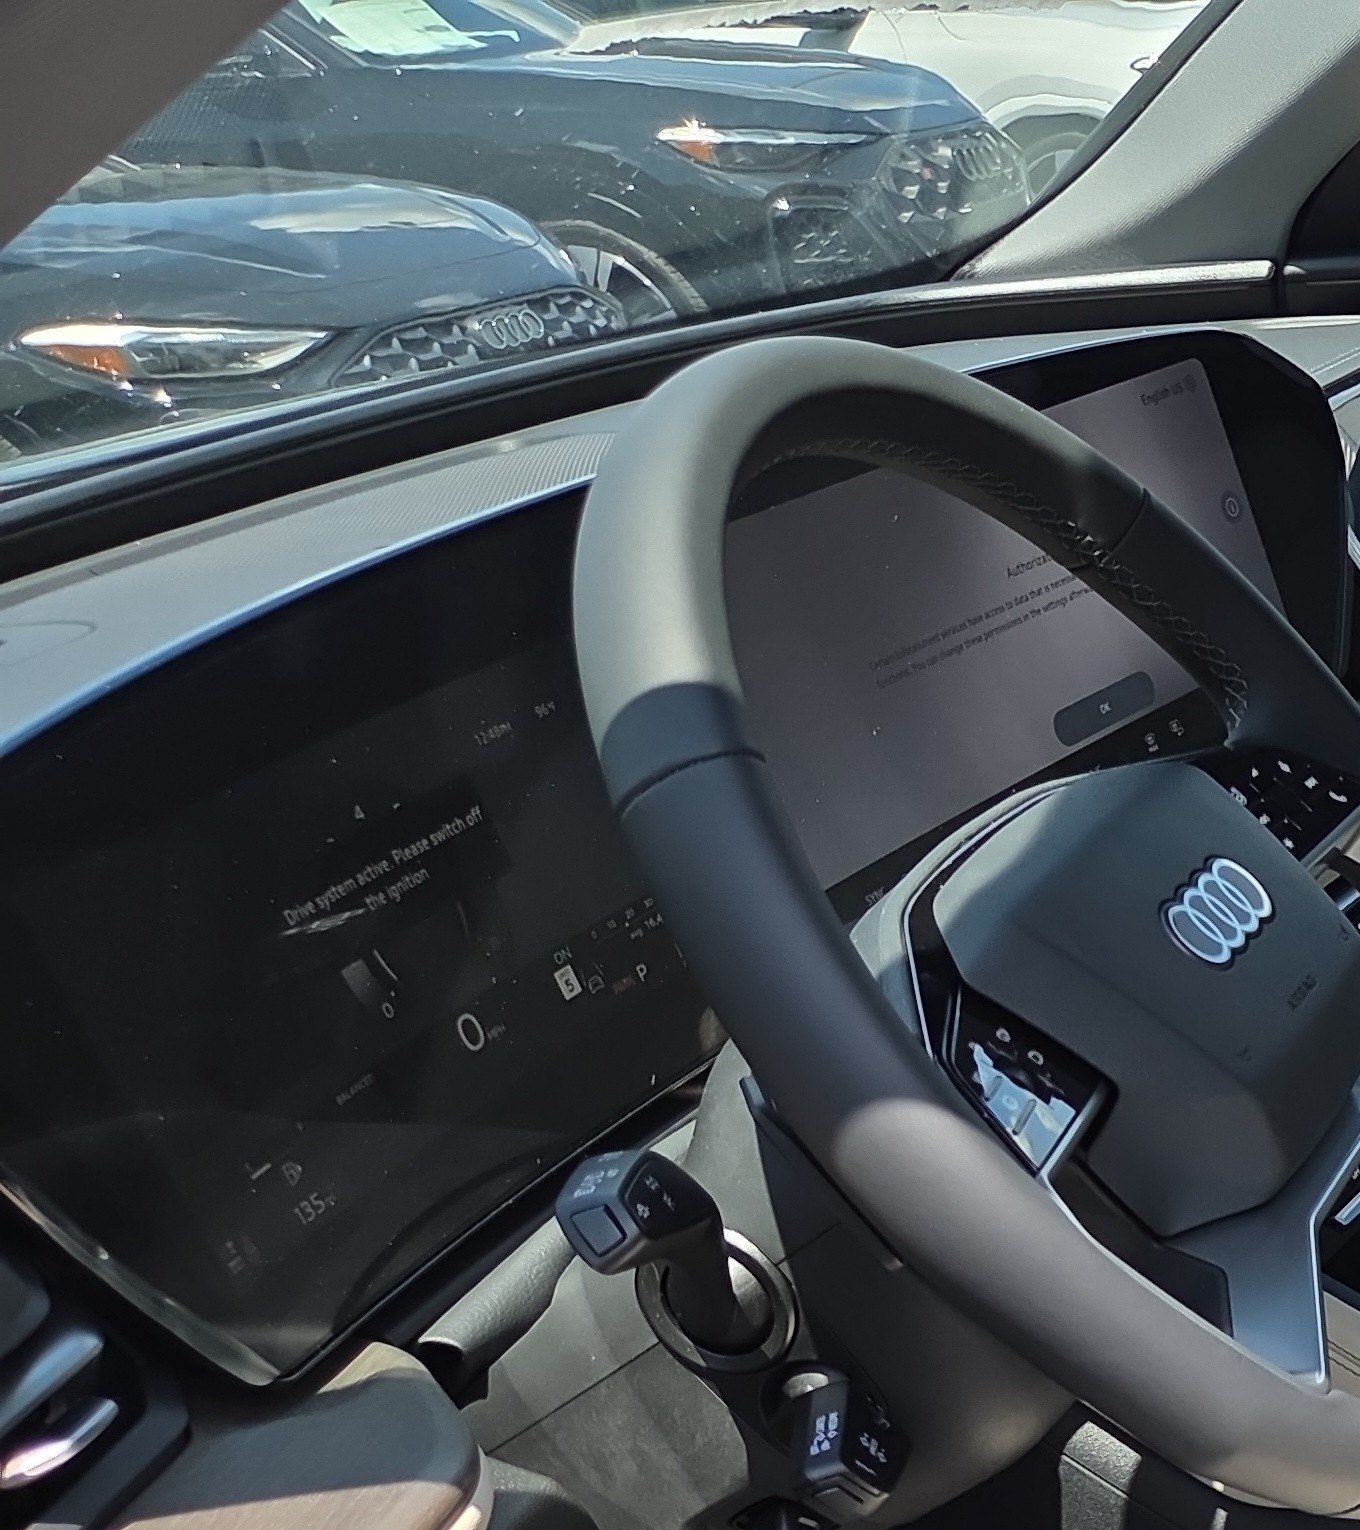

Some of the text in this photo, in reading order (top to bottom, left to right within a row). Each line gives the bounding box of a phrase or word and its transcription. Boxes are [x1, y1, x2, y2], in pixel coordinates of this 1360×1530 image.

[1004, 600, 1015, 611] to
[1013, 594, 1030, 607] data
[1028, 588, 1043, 600] that
[1043, 584, 1052, 594] is
[1028, 608, 1042, 619] the
[1041, 596, 1070, 613] settings
[1099, 701, 1112, 715] OK
[283, 804, 484, 927] Drive system active. Please switch off
[364, 868, 430, 912] the ignition
[552, 945, 573, 965] ON
[635, 962, 648, 983] P
[456, 1012, 485, 1051] 0
